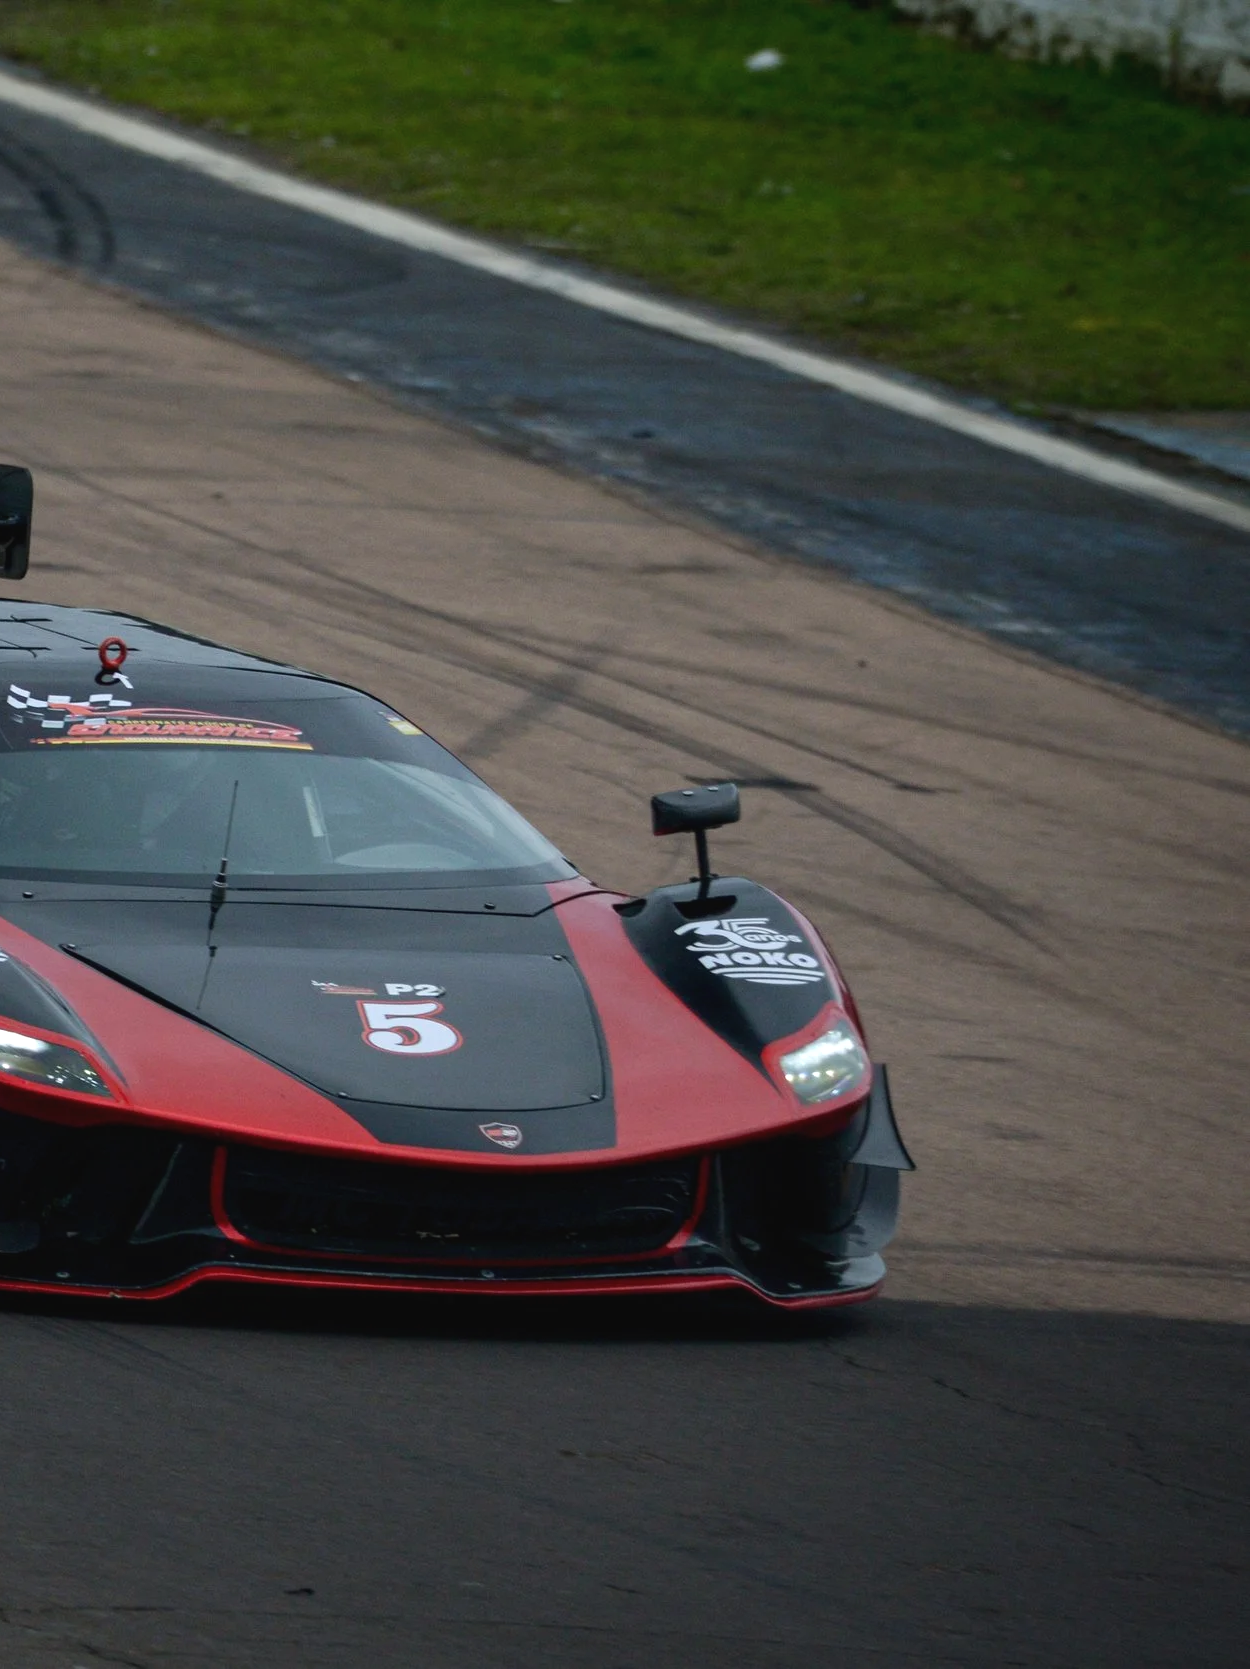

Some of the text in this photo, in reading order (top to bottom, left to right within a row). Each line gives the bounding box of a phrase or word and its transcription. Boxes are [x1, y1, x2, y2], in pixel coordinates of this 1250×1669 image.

[743, 933, 802, 943] anos
[698, 952, 819, 969] NOKO
[384, 983, 440, 997] P2
[356, 999, 464, 1057] 5
